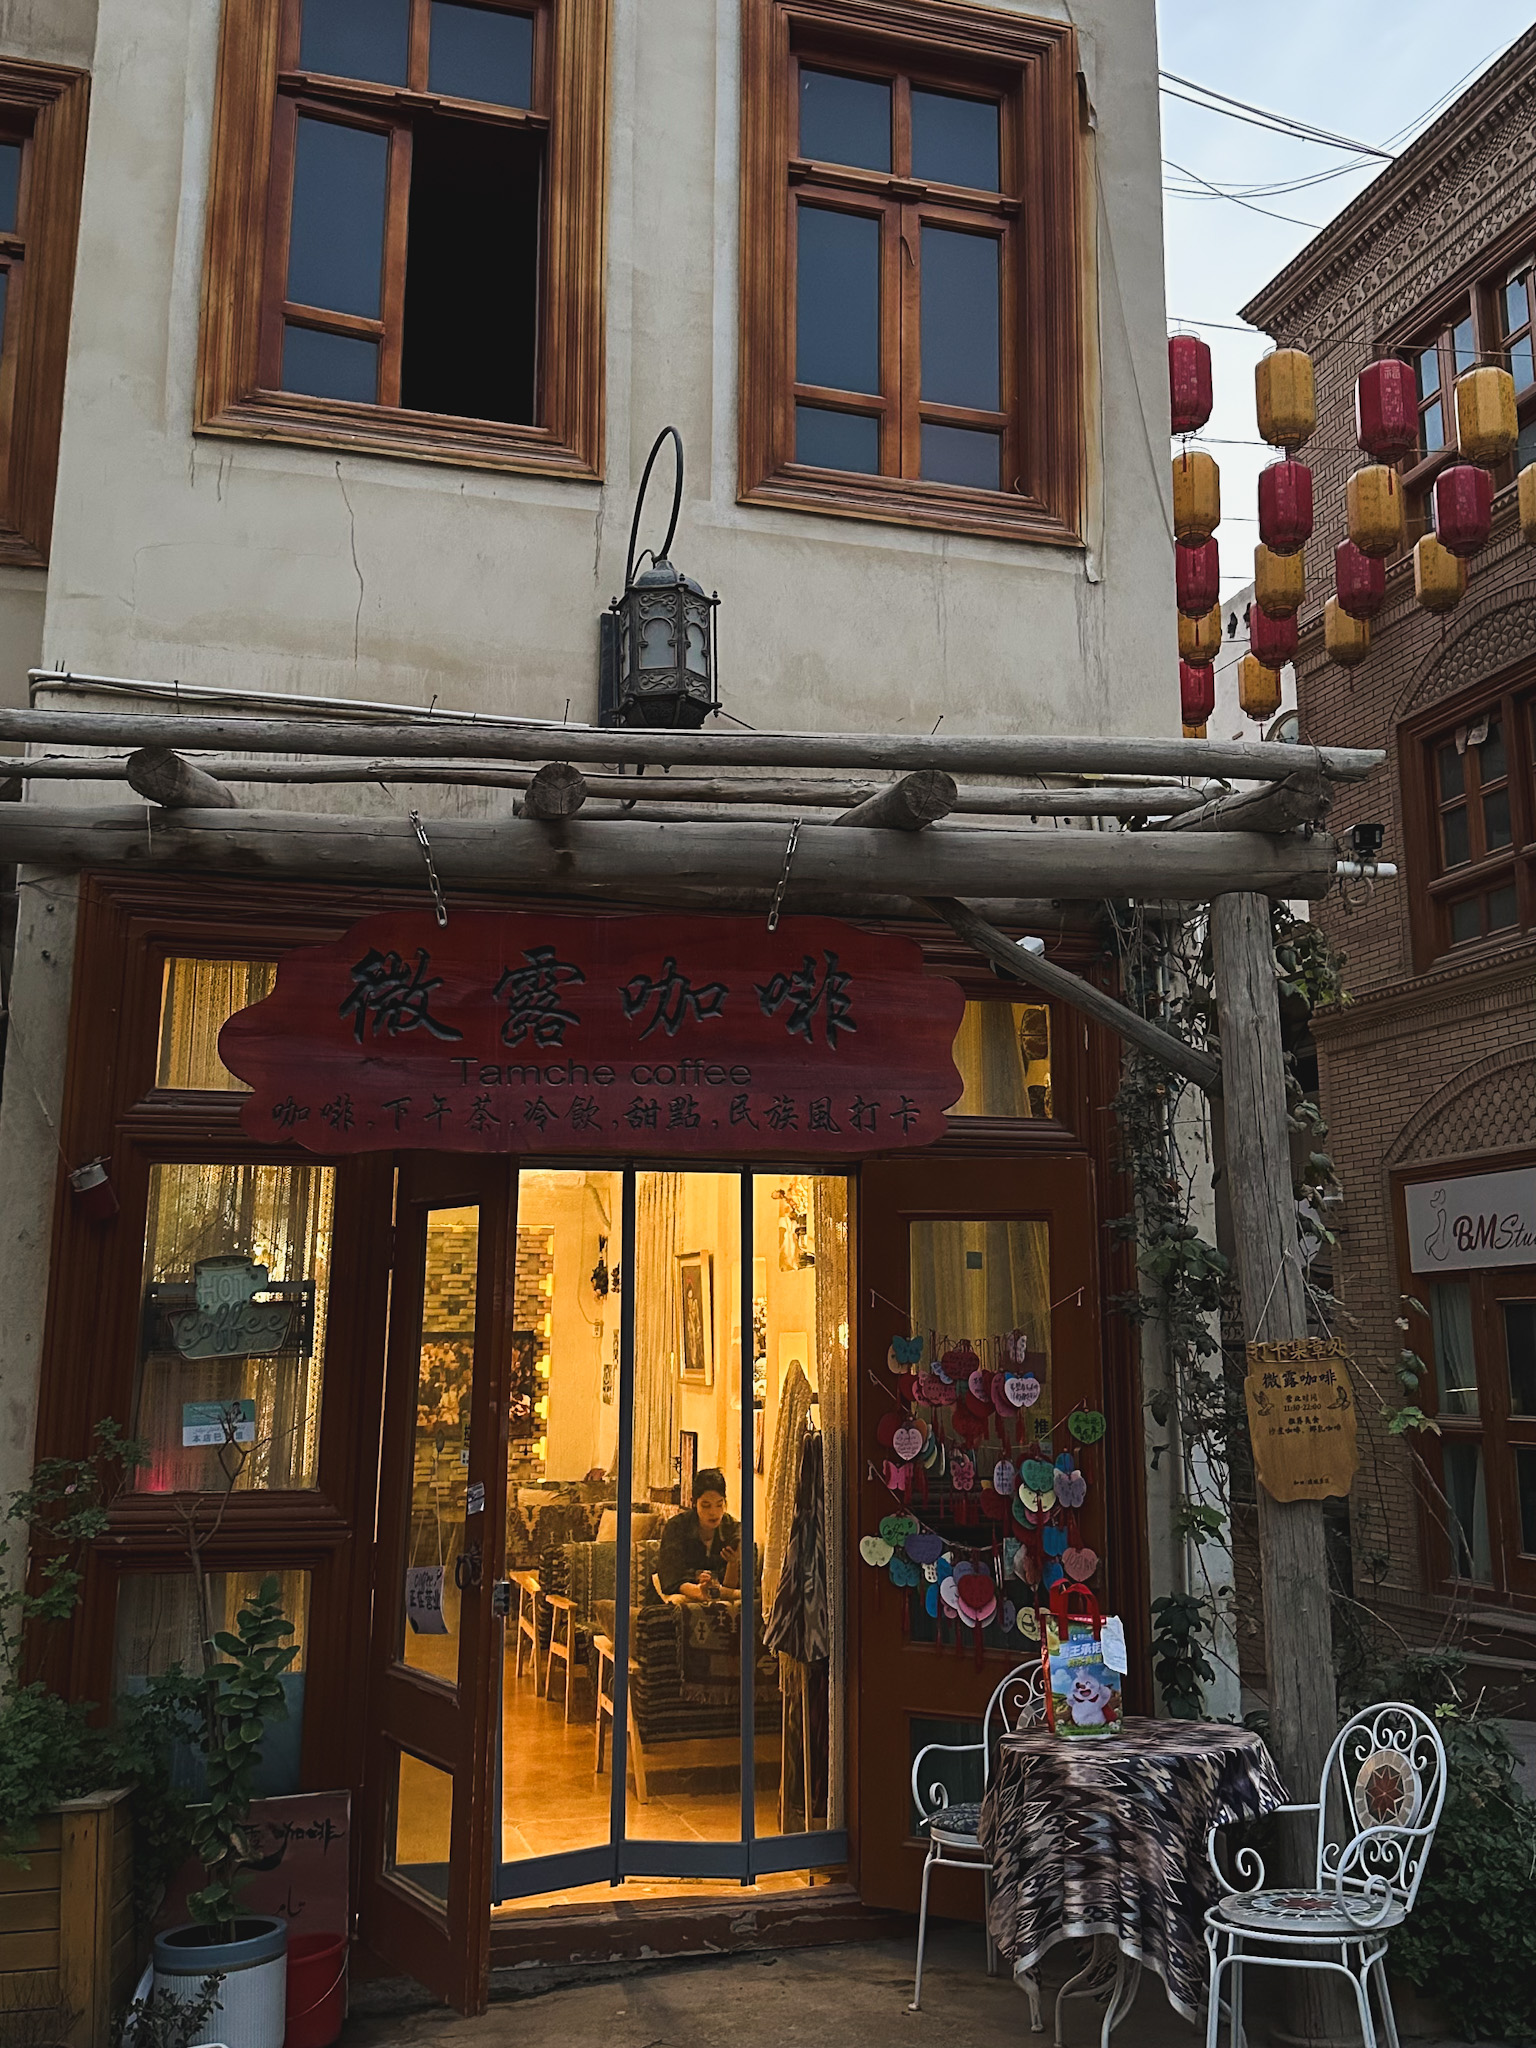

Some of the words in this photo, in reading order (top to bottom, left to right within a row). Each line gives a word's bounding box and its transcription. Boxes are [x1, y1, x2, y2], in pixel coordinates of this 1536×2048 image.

[339, 945, 857, 1050] 微露咖啡
[451, 1057, 615, 1087] Tamche
[631, 1058, 751, 1086] coffee
[200, 1273, 250, 1303] HOT
[175, 1300, 289, 1352] Coffee
[1248, 1336, 1347, 1361] 打卡集章处
[1262, 1369, 1337, 1389] 微露咖啡
[1034, 1418, 1049, 1433] 推
